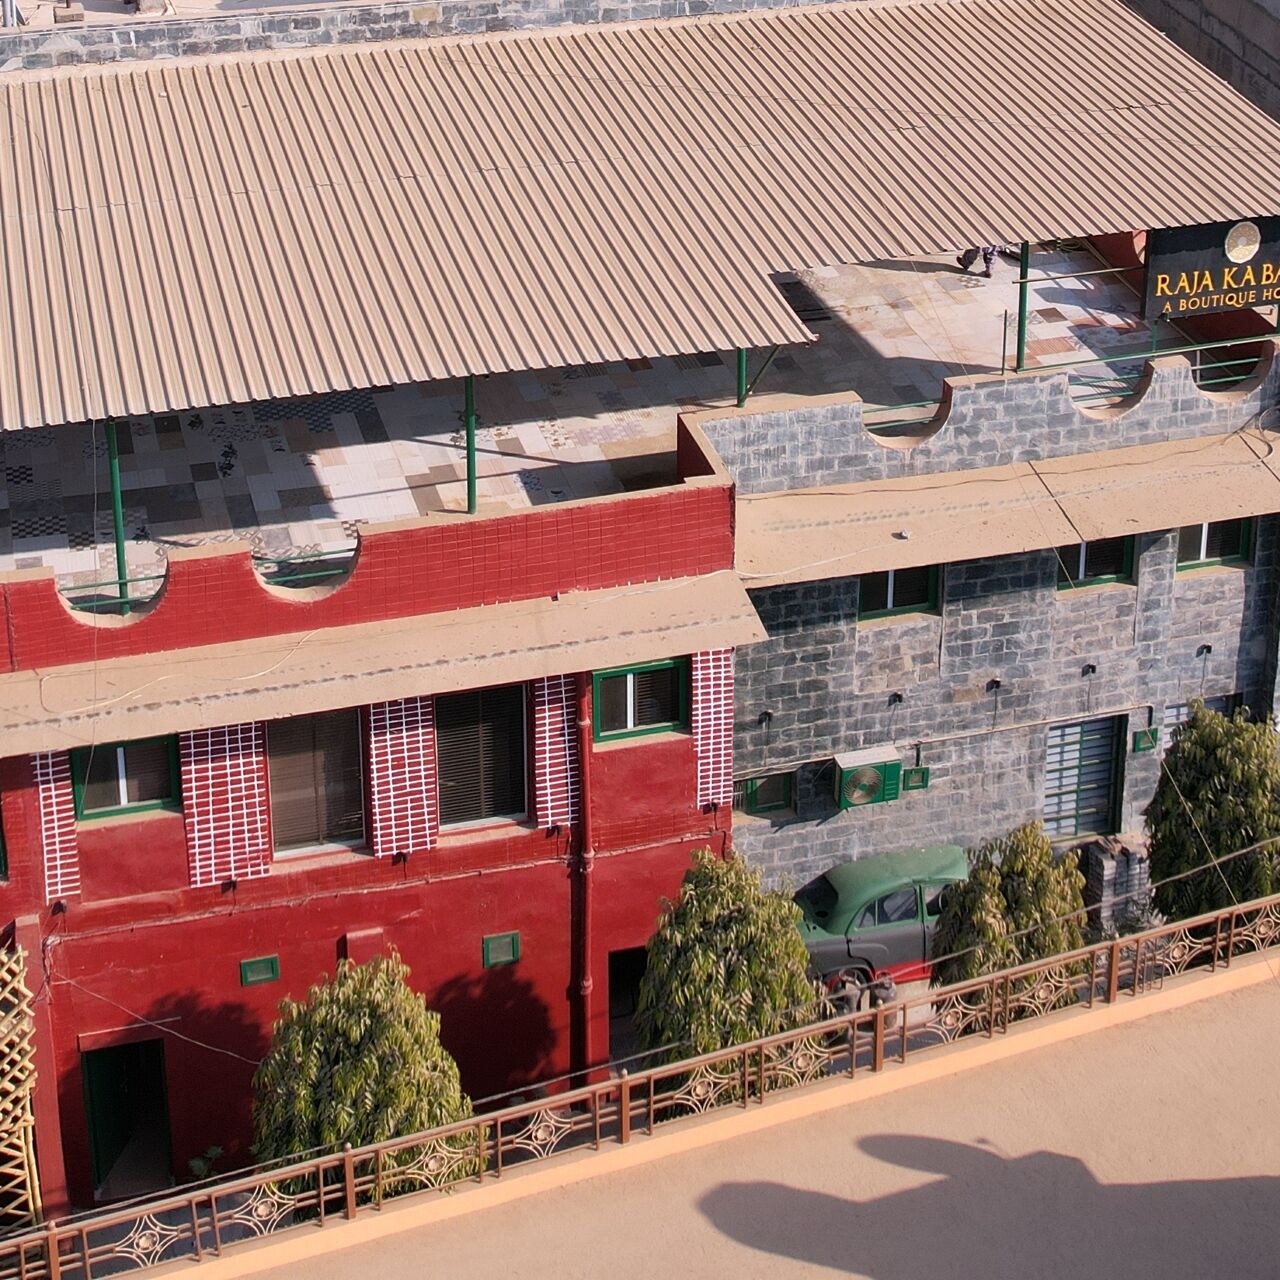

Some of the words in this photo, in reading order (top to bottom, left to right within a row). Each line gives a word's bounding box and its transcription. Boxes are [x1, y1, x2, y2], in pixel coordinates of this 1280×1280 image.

[1155, 270, 1214, 296] RAJA
[1223, 265, 1256, 290] KA
[1162, 301, 1172, 314] A
[1179, 291, 1256, 311] BOUTIQUE
